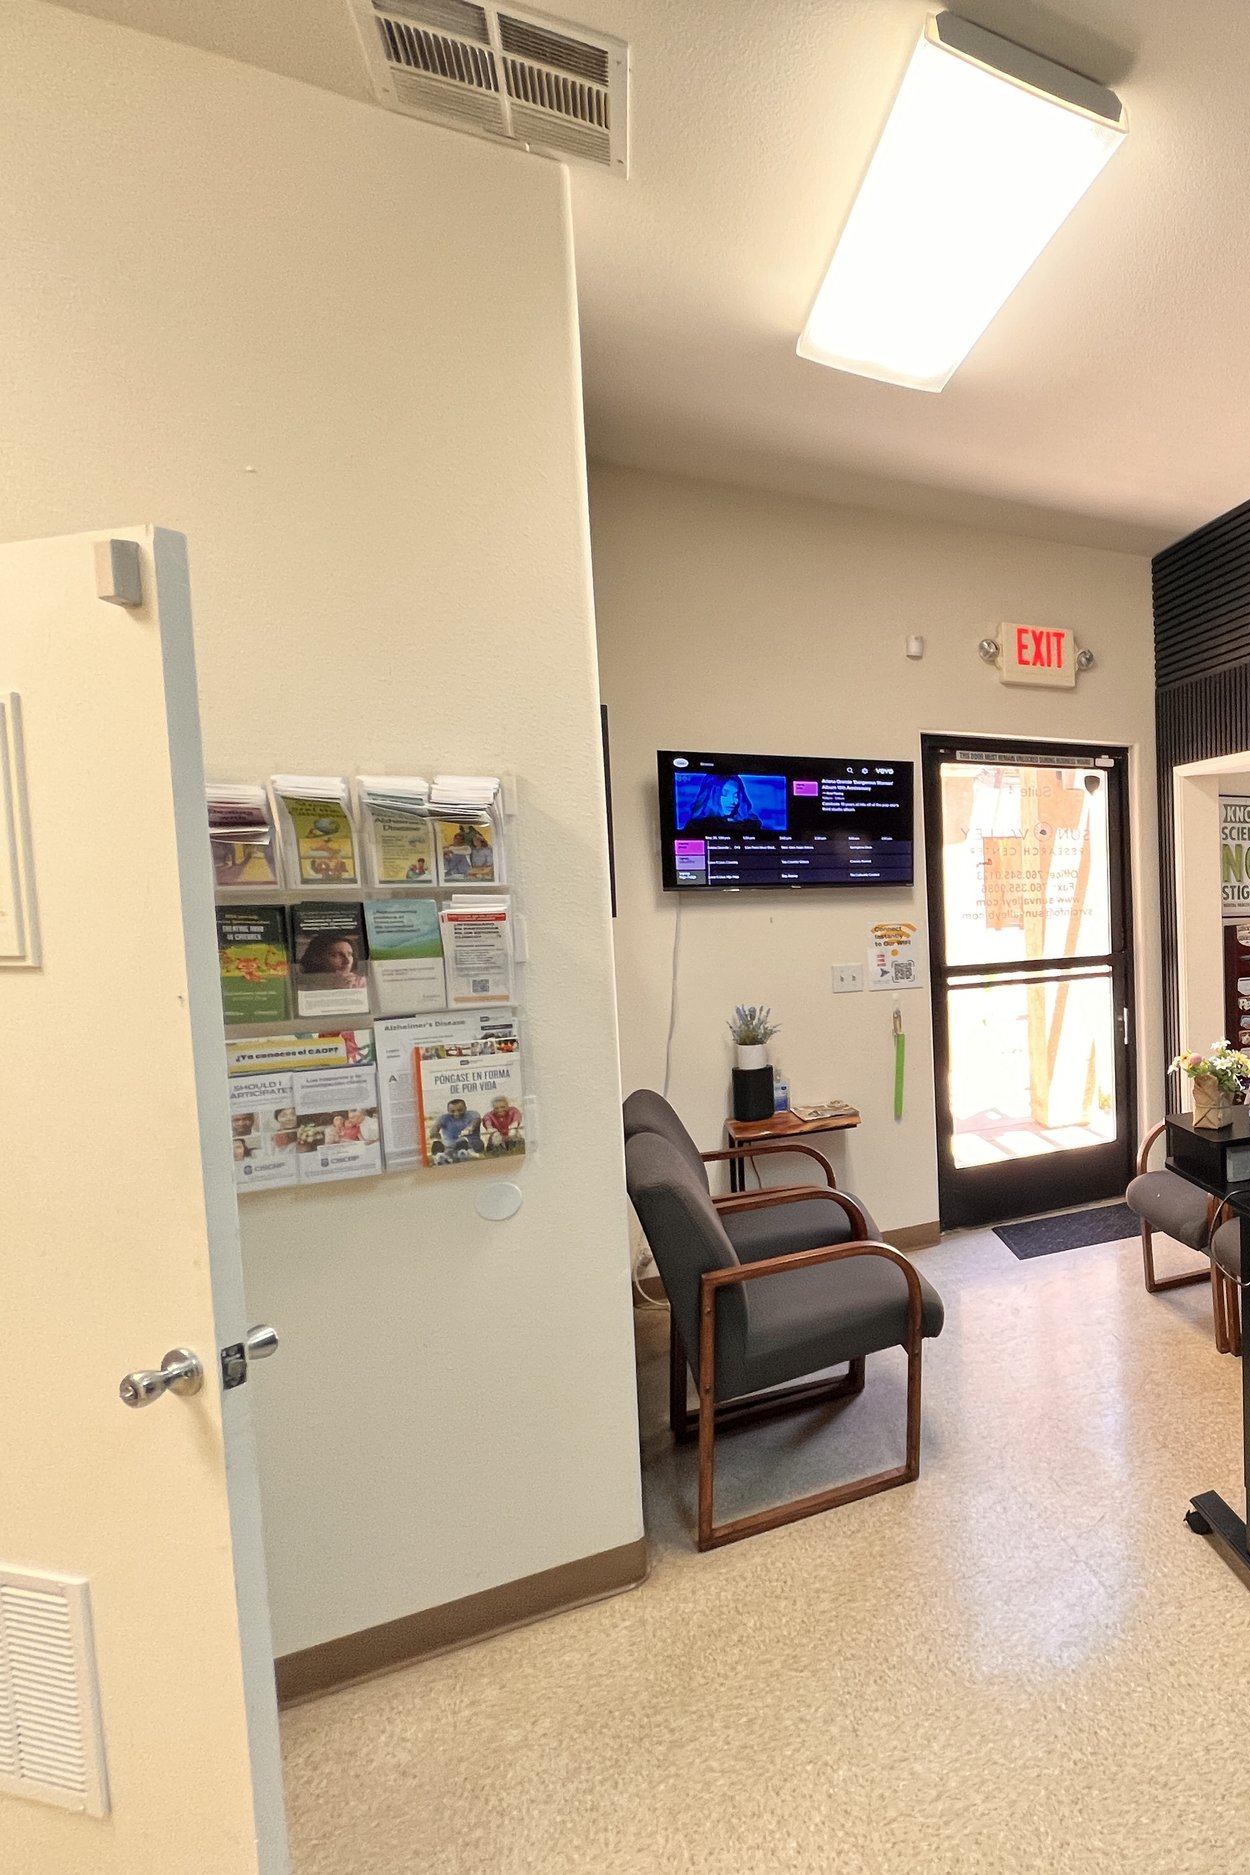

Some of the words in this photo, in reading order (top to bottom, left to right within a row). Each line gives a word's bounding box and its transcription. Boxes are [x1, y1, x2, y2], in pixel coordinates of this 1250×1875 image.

[1016, 627, 1065, 668] EXIT
[384, 1022, 433, 1032] Alzheimer's
[434, 1073, 470, 1085] PÓNGASE
[472, 1071, 482, 1081] EN
[484, 1069, 510, 1080] FORMA
[234, 1081, 276, 1091] SHOULD
[450, 1085, 460, 1094] DE
[462, 1083, 478, 1093] POR
[480, 1081, 497, 1091] VIDA
